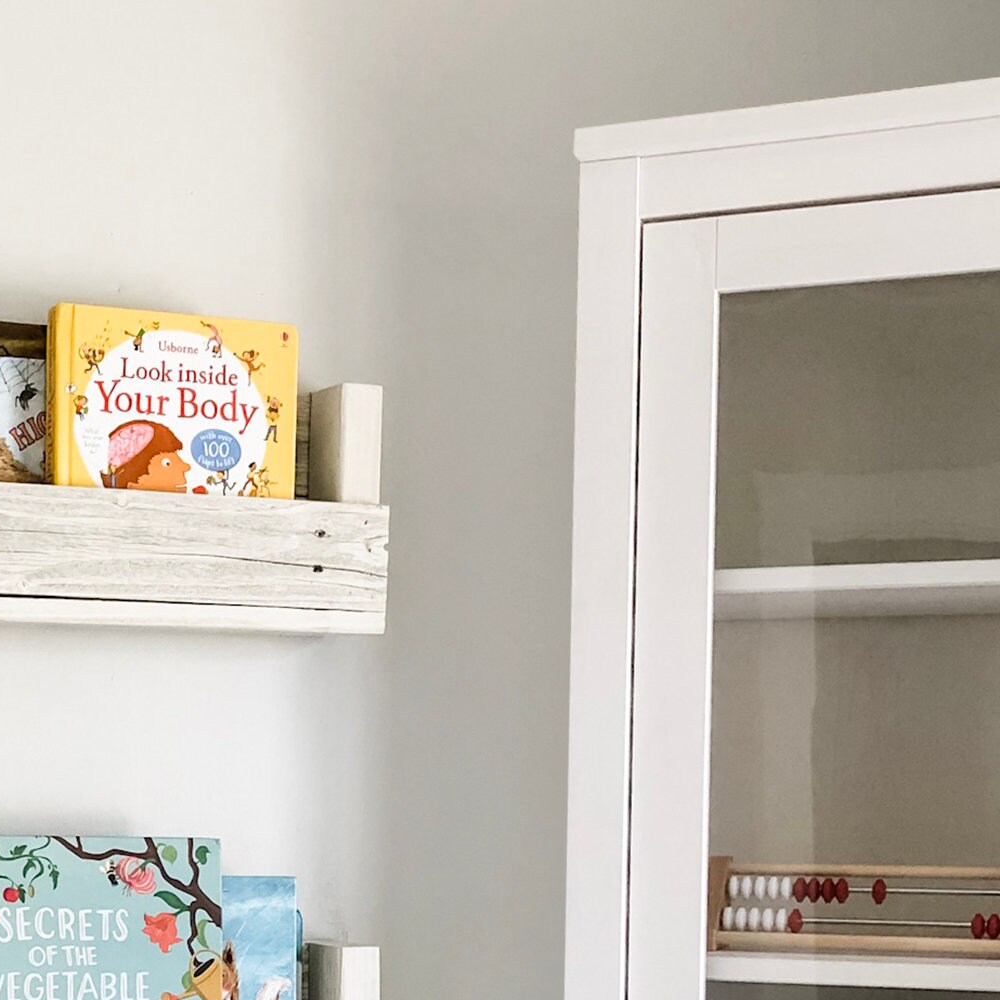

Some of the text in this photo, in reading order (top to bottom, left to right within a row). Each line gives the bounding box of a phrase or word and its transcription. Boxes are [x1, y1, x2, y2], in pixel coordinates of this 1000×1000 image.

[158, 340, 199, 356] Usborne
[120, 357, 239, 387] Look inside
[94, 380, 260, 435] Your Body
[203, 441, 230, 458] 100
[28, 945, 99, 967] OF THE
